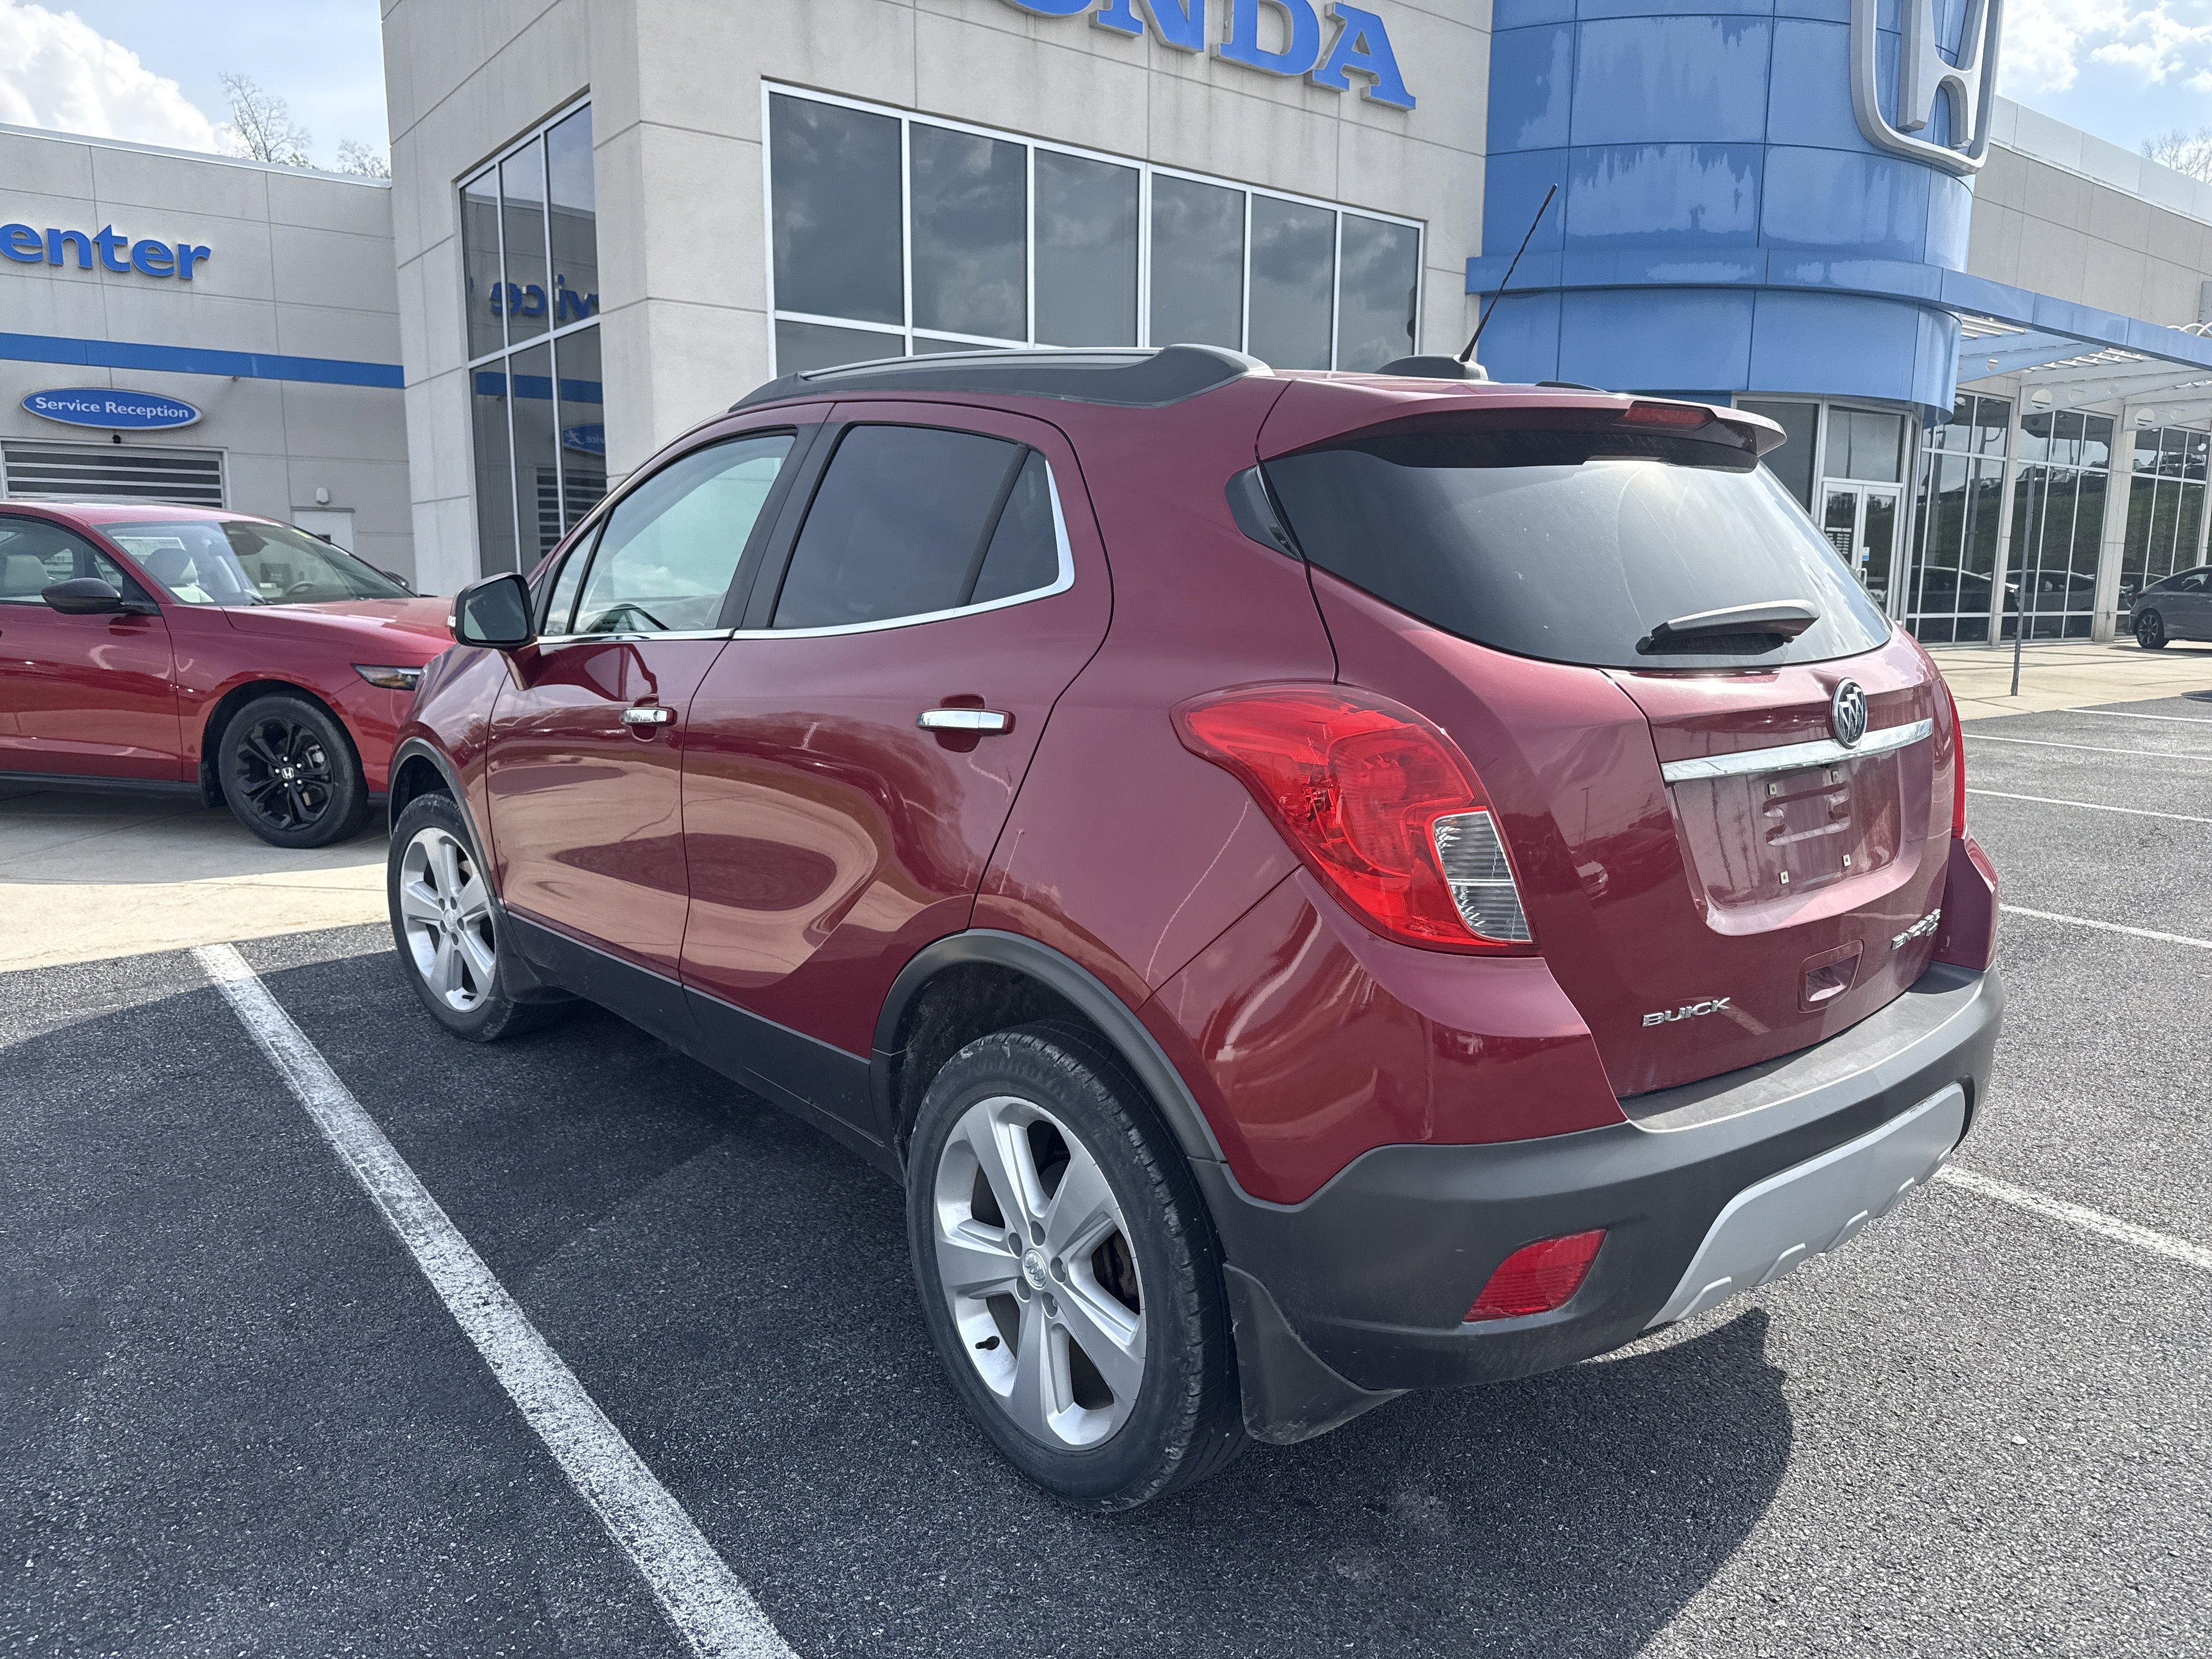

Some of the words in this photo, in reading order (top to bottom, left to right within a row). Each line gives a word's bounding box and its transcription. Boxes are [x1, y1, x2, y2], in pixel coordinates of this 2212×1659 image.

[994, 0, 1417, 111] DA
[0, 223, 211, 279] enter
[35, 397, 101, 413] Service
[105, 401, 189, 419] Reception
[1642, 997, 1730, 1027] BUICK
